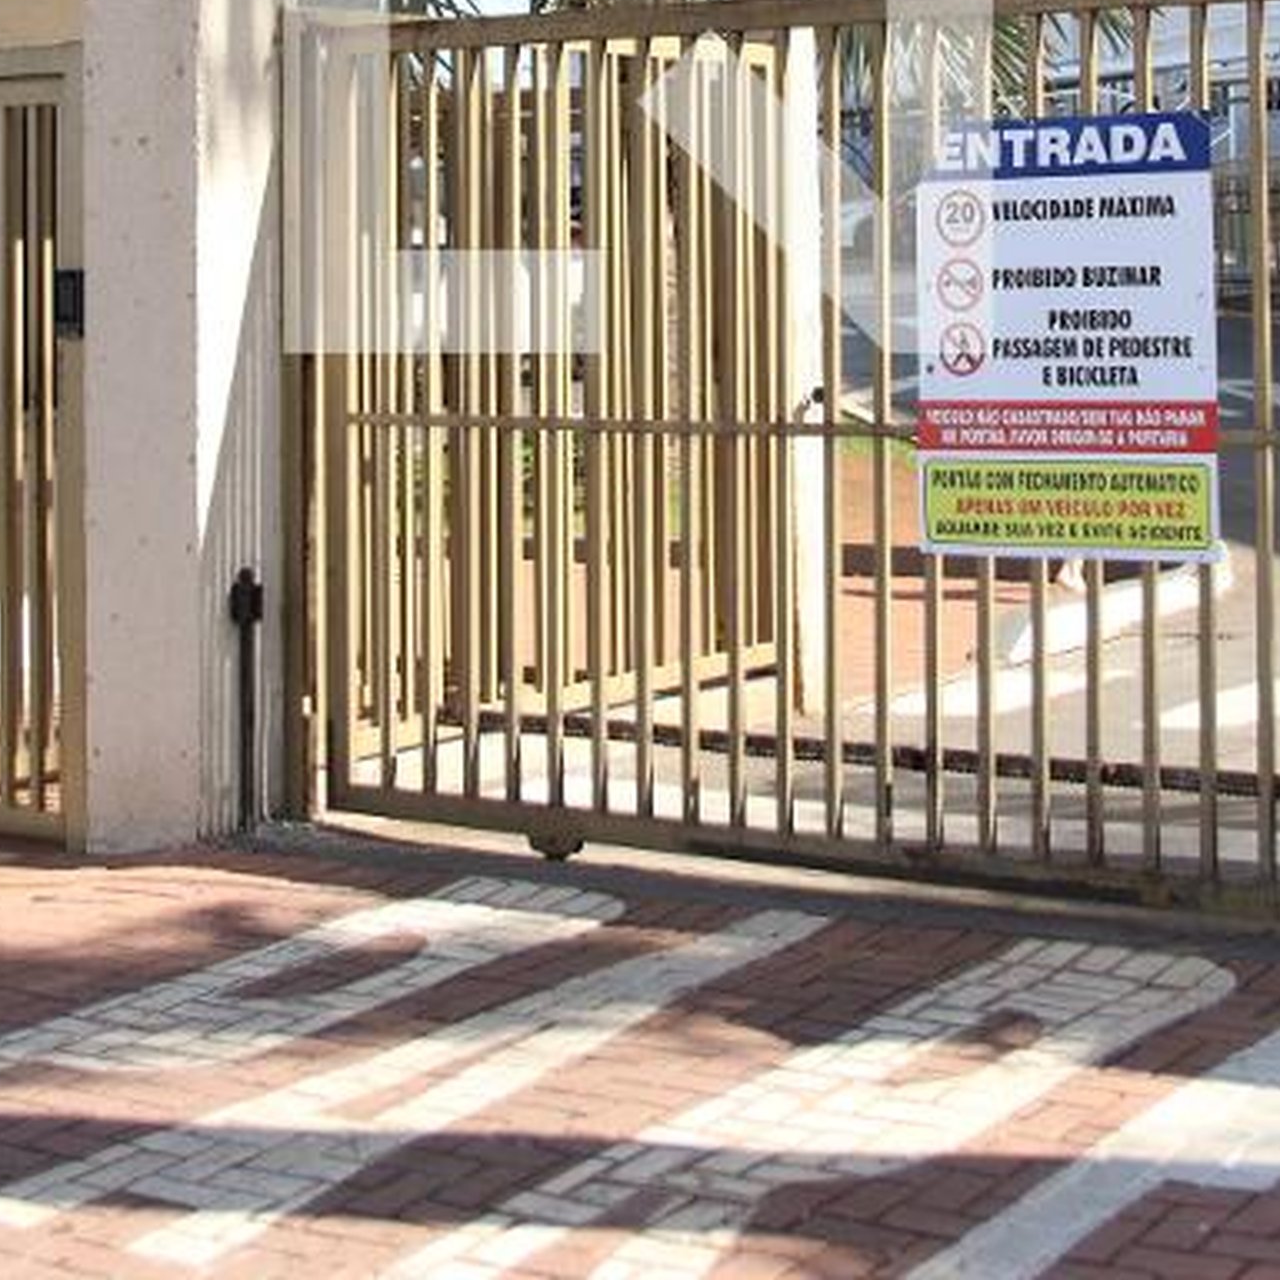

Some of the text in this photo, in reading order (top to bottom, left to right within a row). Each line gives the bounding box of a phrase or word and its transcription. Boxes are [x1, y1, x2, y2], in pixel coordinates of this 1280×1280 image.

[936, 122, 1188, 171] ENTRADA
[945, 200, 975, 225] 20
[992, 197, 1094, 222] VELOCIDADE
[991, 265, 1162, 290] PROIBIDO BUZINAR
[1048, 309, 1132, 331] PROIBIDO
[991, 335, 1194, 360] PASSAGEM DE PEDESTRE
[1056, 365, 1140, 387] BICICLETA
